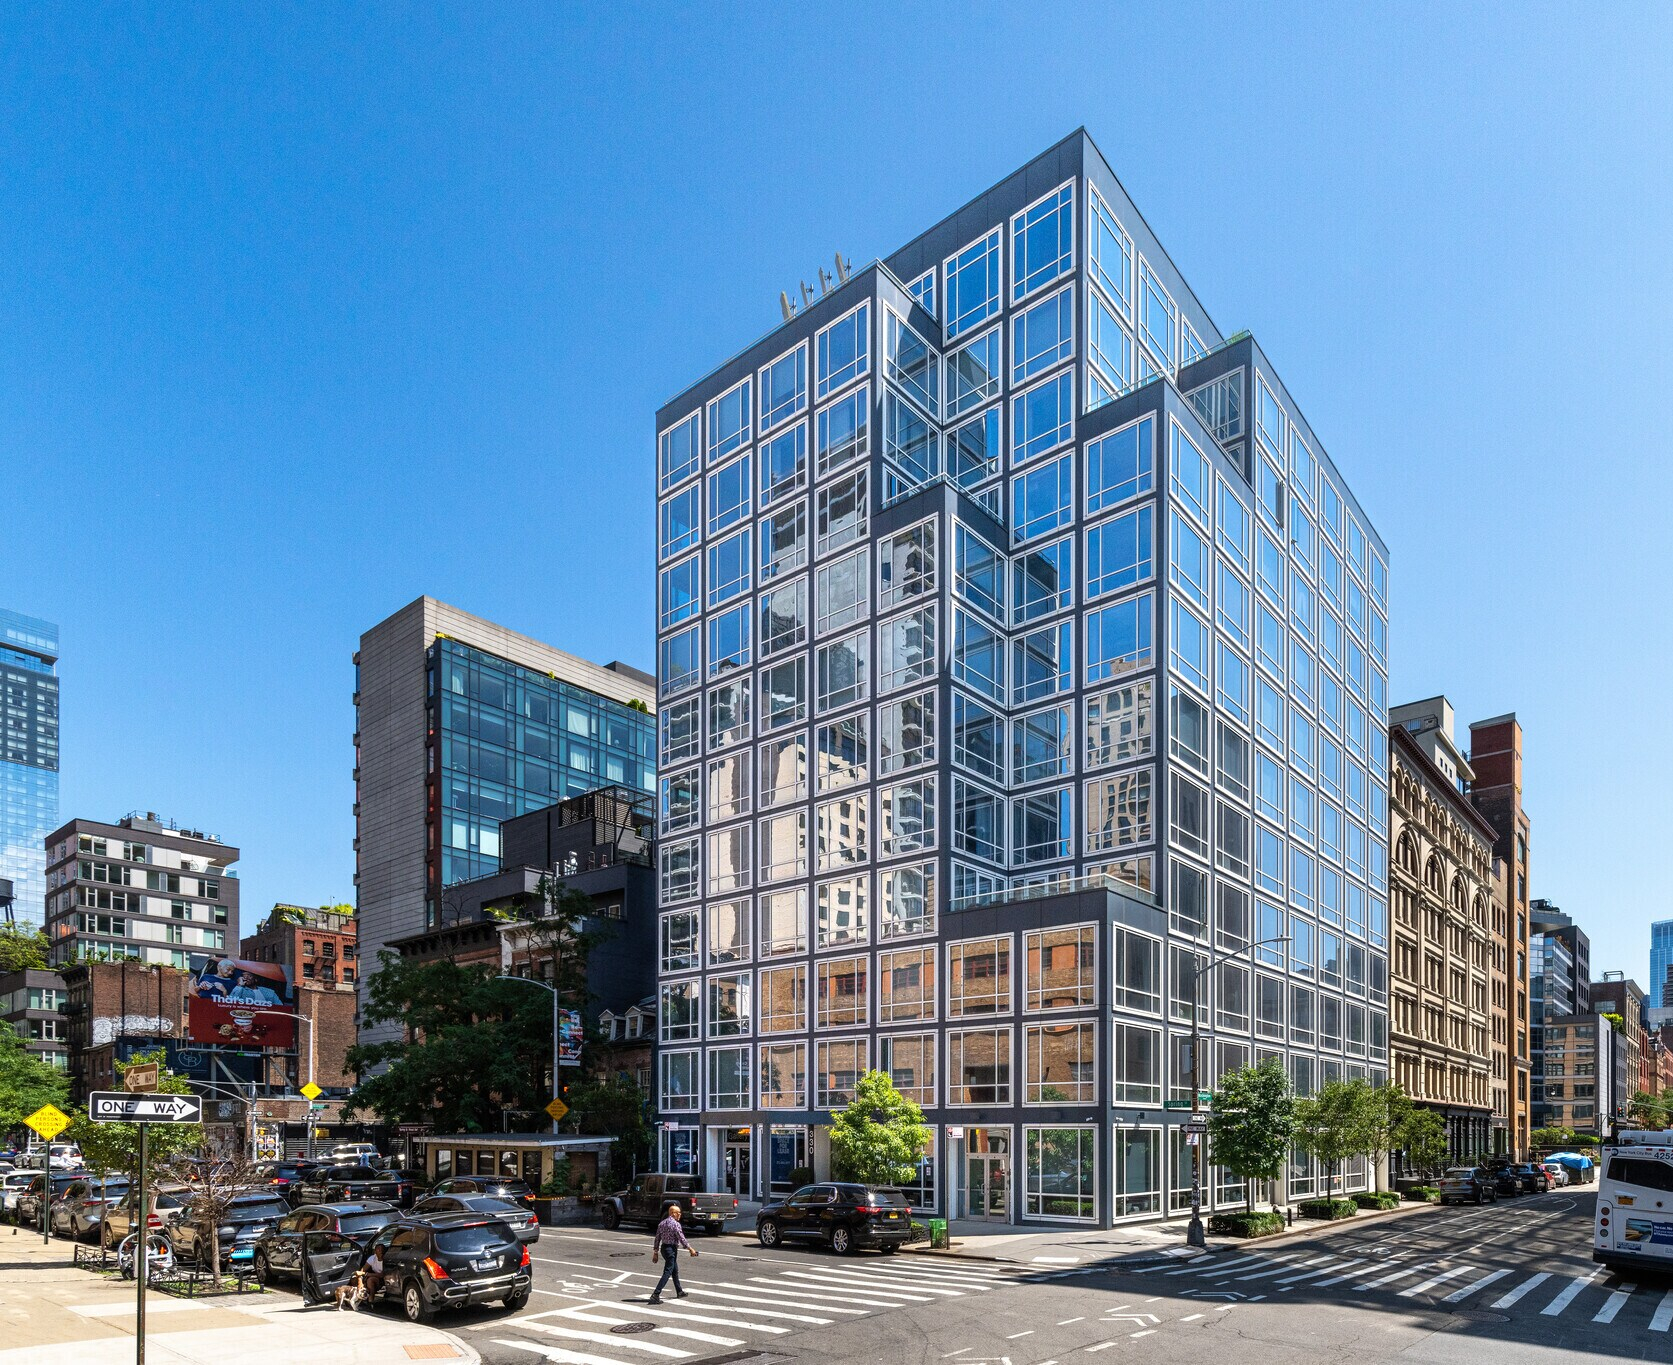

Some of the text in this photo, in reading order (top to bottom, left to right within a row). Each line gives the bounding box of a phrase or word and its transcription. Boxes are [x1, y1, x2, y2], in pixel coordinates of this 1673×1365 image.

[246, 997, 272, 1007] Dazs
[129, 1071, 156, 1086] ONE WAY
[101, 1101, 187, 1114] ONE WAY
[728, 1133, 748, 1142] Gallery
